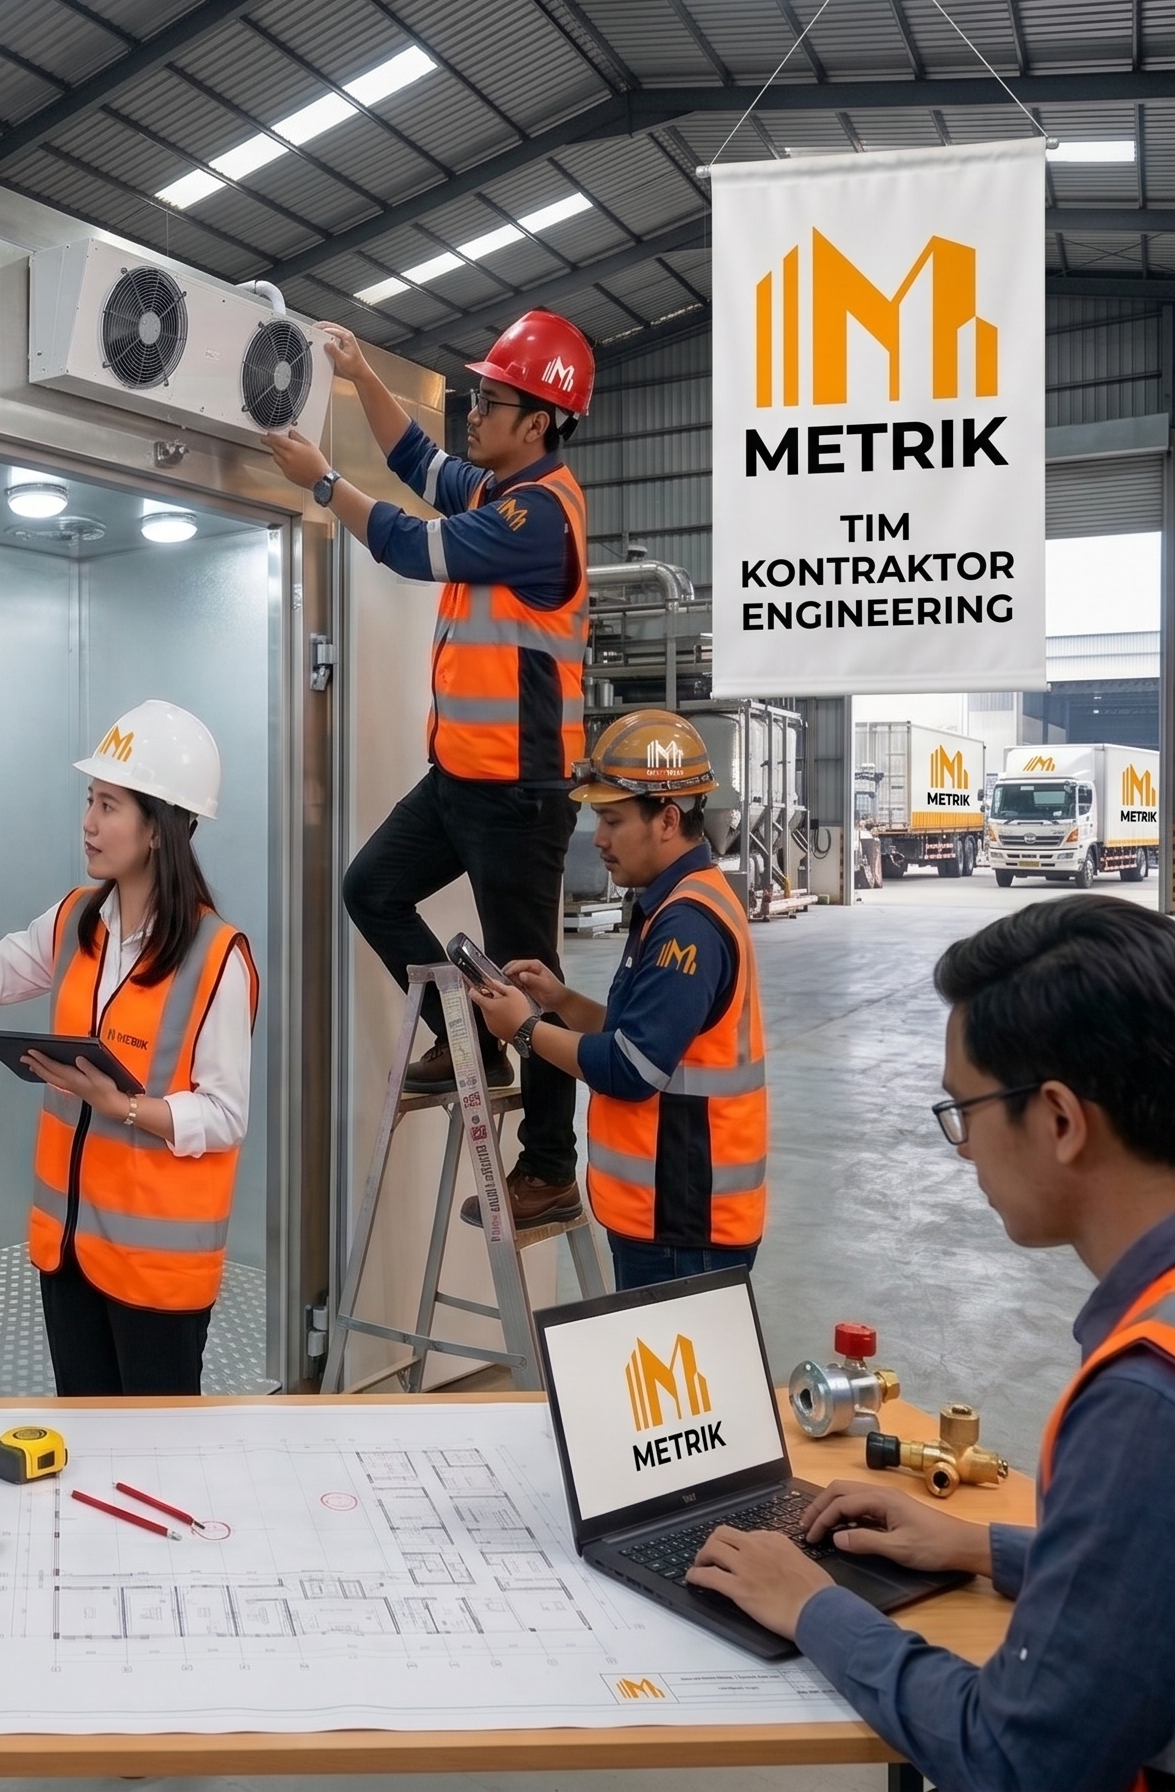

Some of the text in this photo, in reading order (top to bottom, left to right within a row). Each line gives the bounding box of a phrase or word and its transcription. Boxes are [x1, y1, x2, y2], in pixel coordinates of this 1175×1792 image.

[745, 416, 1009, 477] METRIK
[839, 512, 910, 543] TIM
[741, 550, 1015, 589] KONTRAKTOR
[741, 593, 1014, 632] ENGINEERING
[927, 791, 971, 807] METRIK
[1120, 809, 1158, 823] METRIK
[632, 1420, 727, 1472] METRIK
